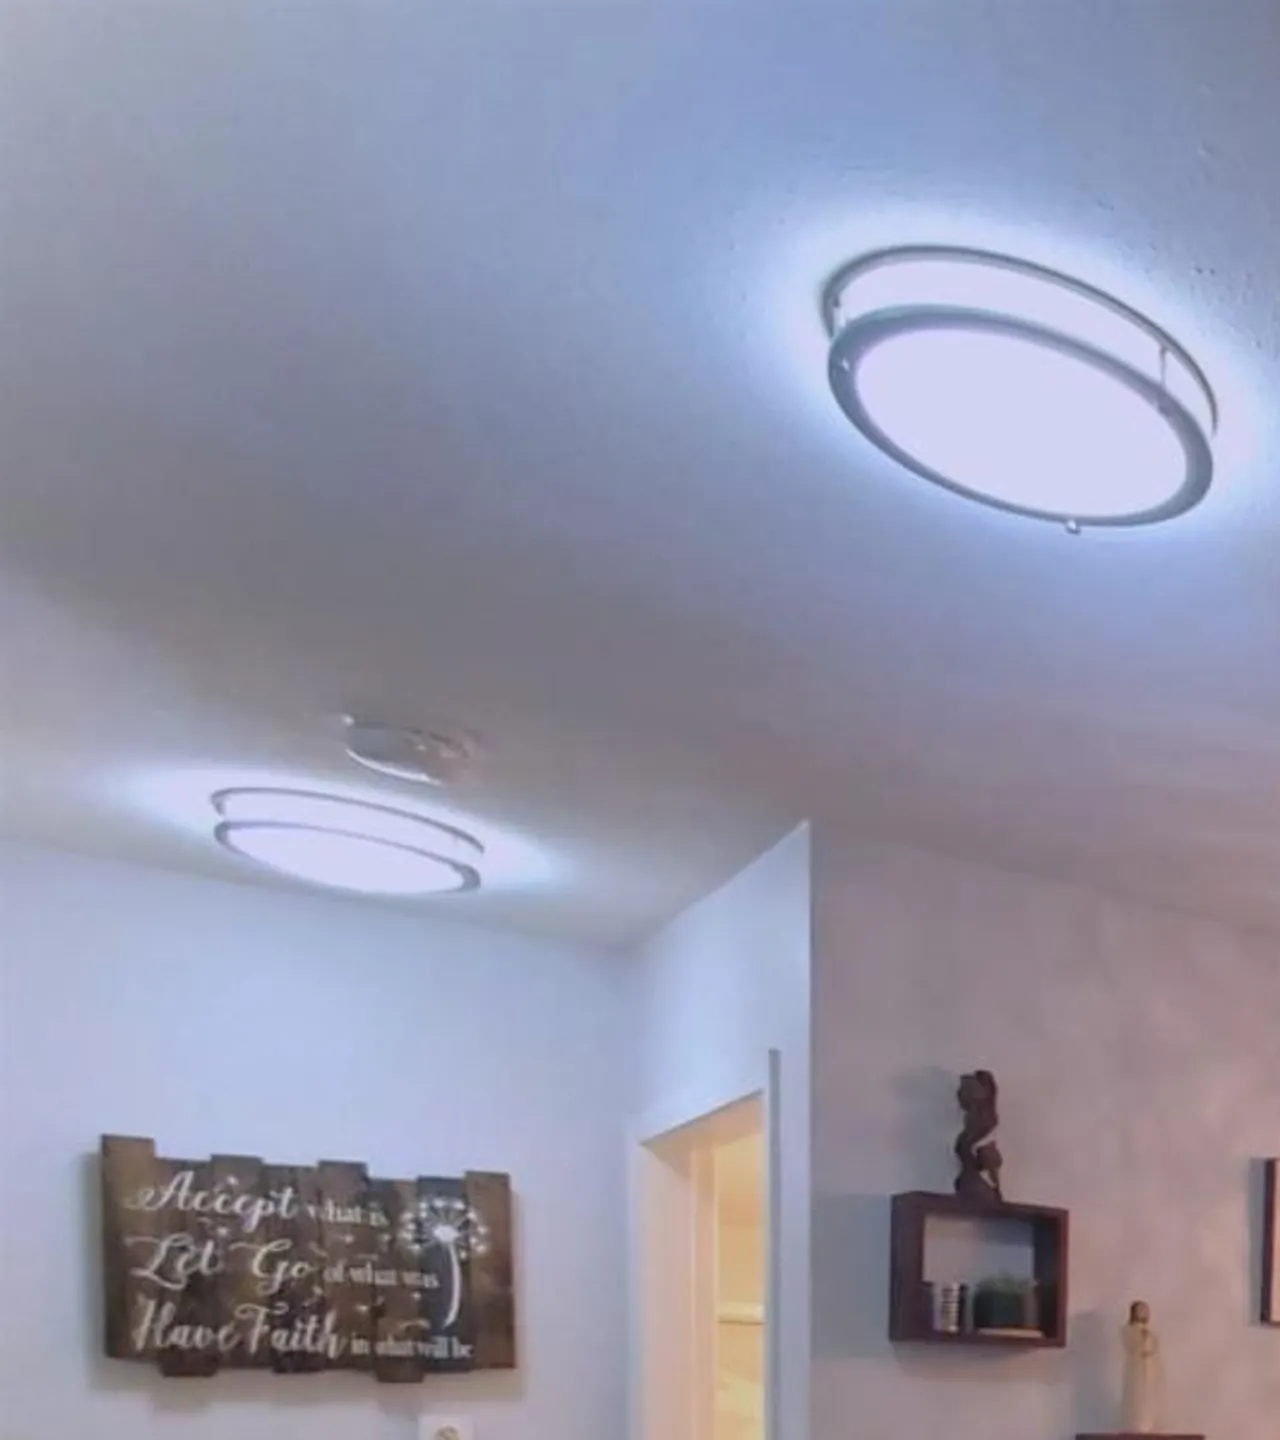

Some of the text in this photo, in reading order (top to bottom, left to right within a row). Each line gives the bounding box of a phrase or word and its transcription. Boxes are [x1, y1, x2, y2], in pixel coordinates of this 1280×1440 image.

[126, 1170, 299, 1233] Accept
[124, 1233, 223, 1291] Let
[229, 1239, 319, 1295] Go
[132, 1293, 239, 1352] Have
[234, 1302, 347, 1359] Faith
